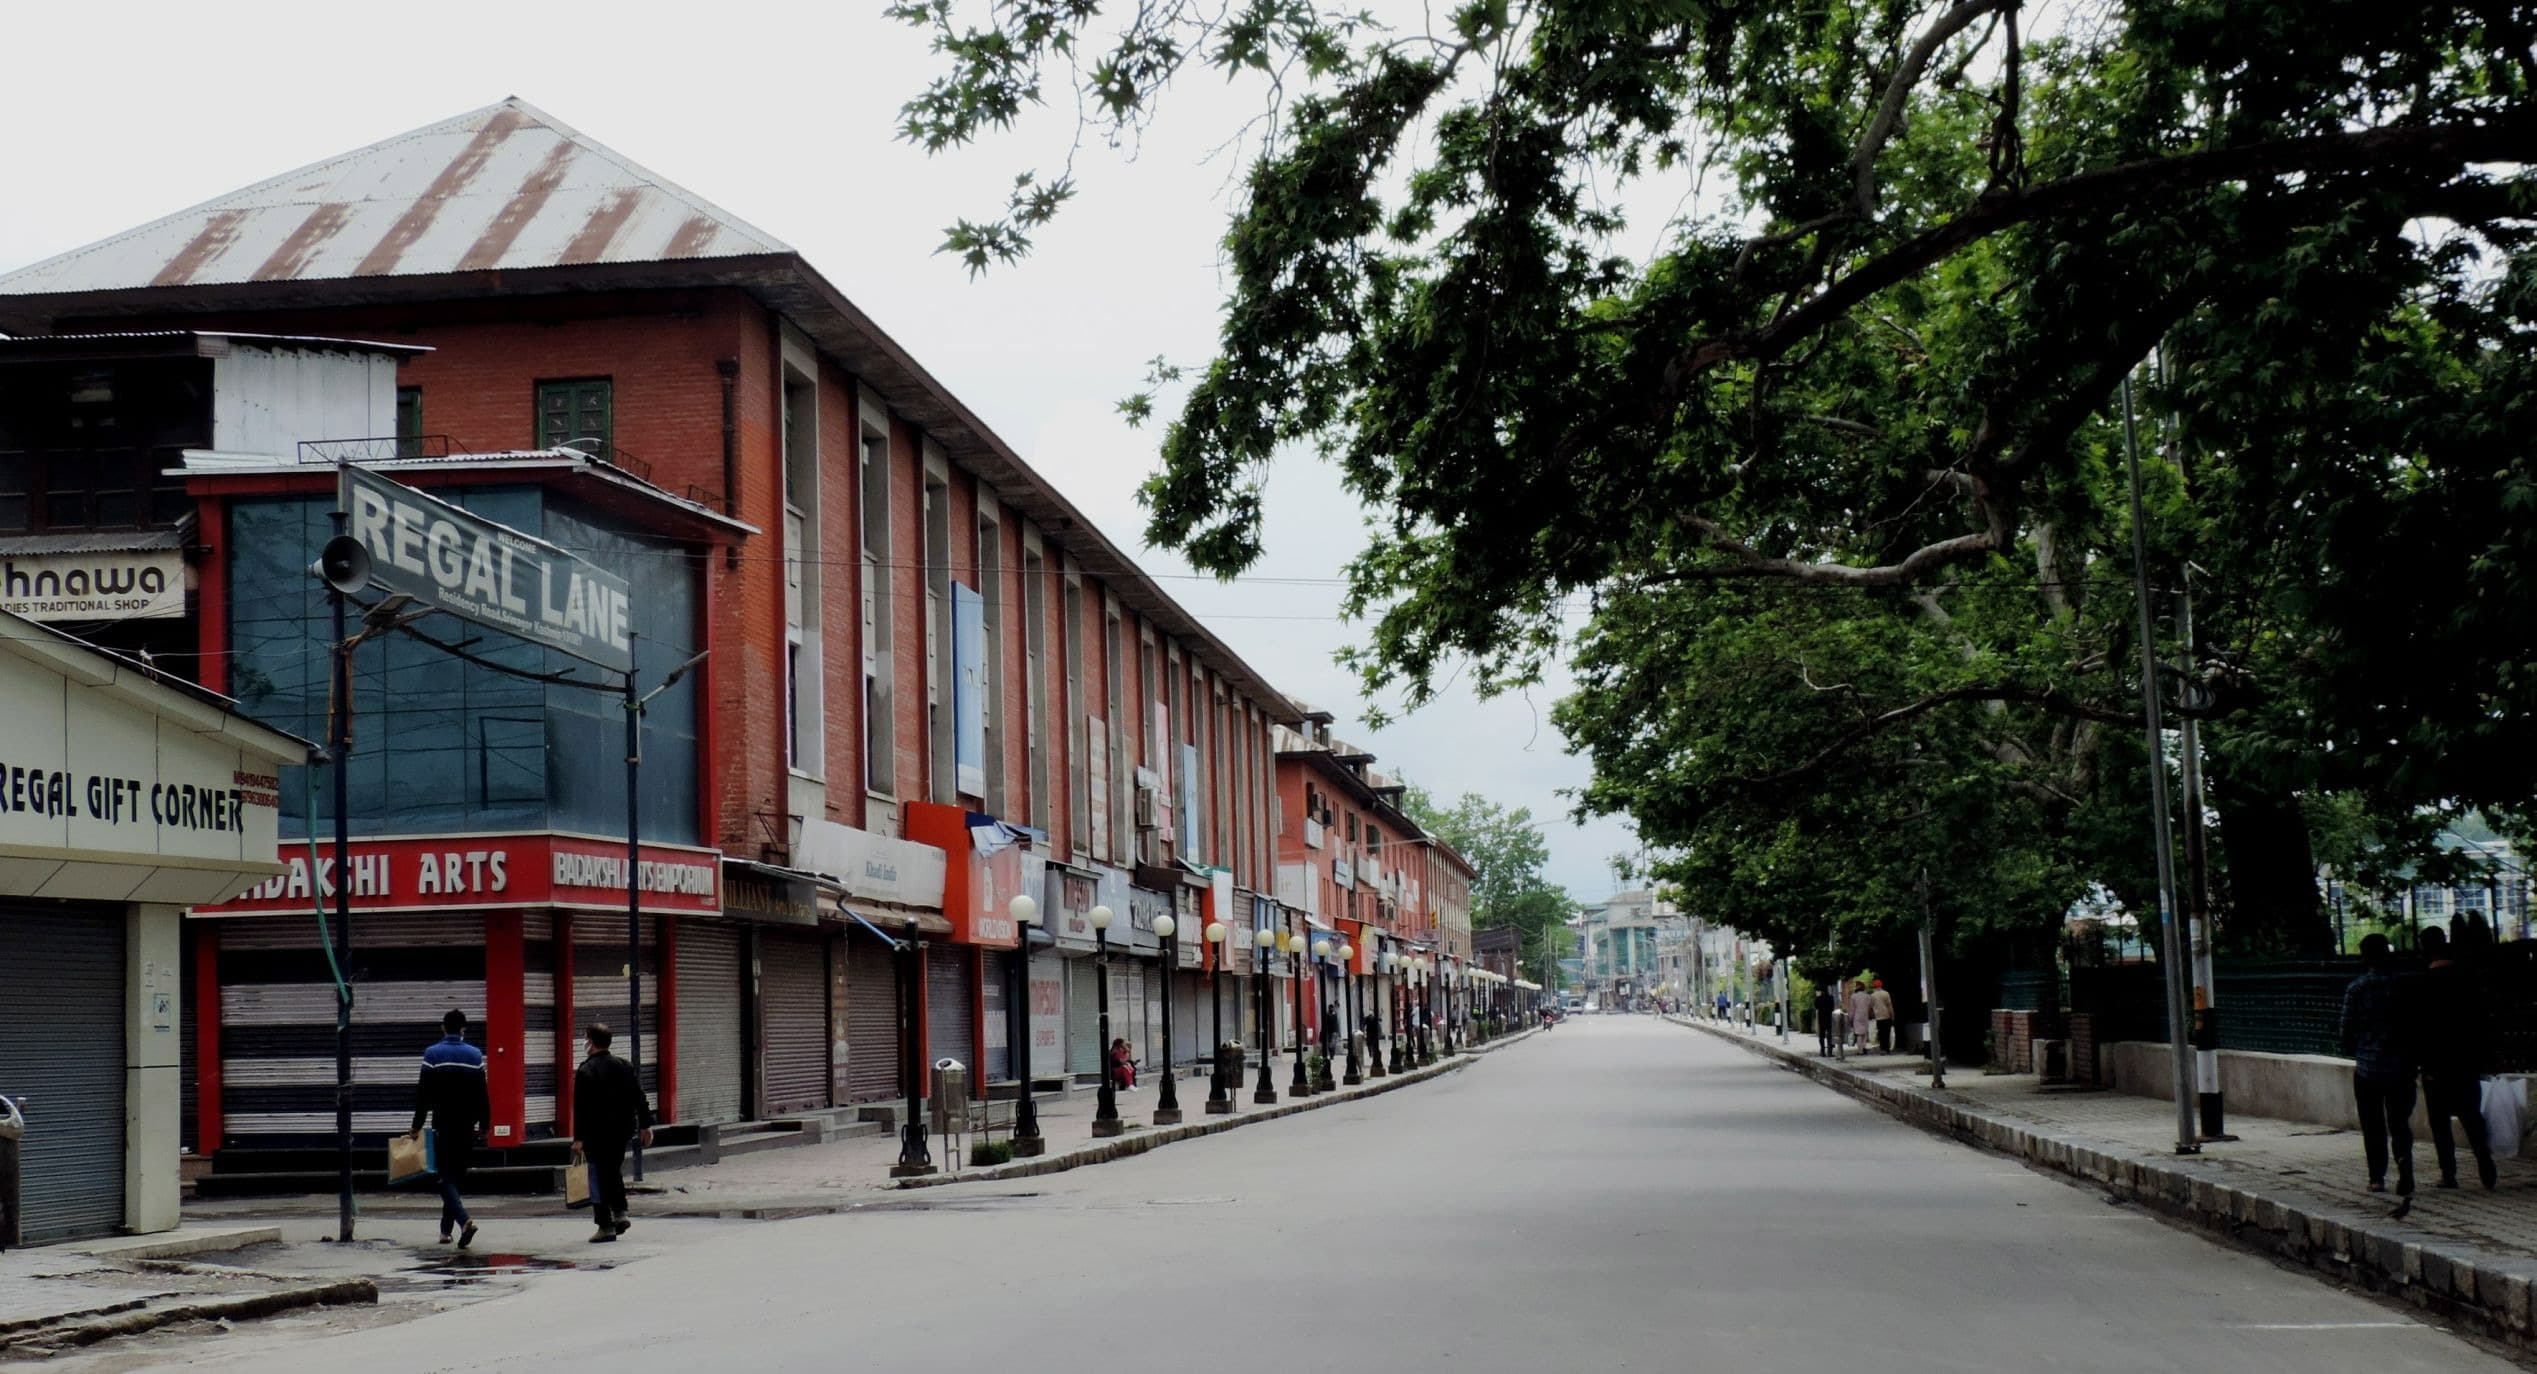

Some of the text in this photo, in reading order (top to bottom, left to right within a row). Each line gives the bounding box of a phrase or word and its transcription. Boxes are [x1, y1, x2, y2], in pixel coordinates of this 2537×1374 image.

[497, 531, 537, 554] WELCOME
[0, 562, 165, 597] hnawa
[353, 484, 629, 651] REGAL LANE
[0, 599, 149, 614] DIES TRADITIONAL SHOP
[438, 586, 480, 617] Residency
[87, 775, 141, 825] GIFT
[151, 783, 243, 835] CORNER
[418, 850, 506, 894] ARTS
[553, 852, 621, 889] BADAKSHI
[656, 862, 714, 896] EMPORIUM
